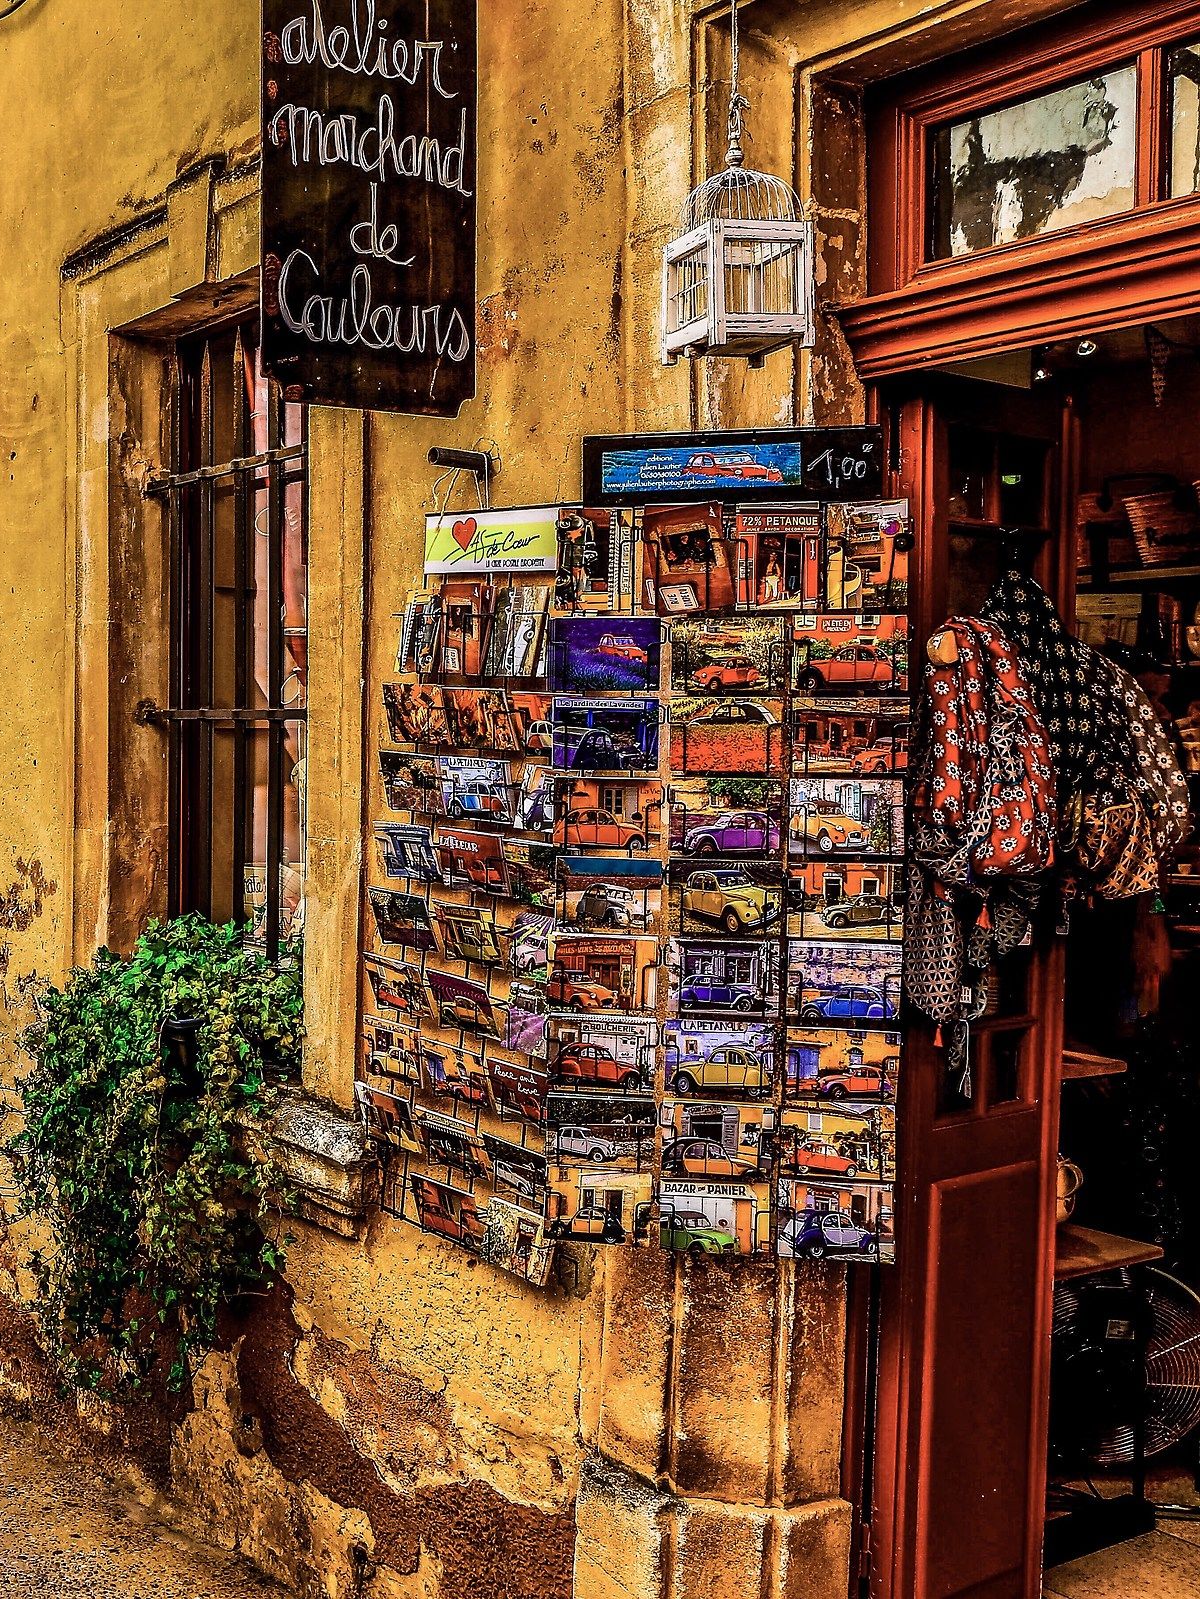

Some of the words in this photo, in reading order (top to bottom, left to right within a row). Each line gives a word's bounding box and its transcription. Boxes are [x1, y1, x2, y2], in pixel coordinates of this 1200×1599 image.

[282, 0, 458, 98] atelier
[272, 94, 472, 197] marchand
[350, 182, 415, 266] de
[278, 249, 470, 361] Couleurs
[742, 516, 762, 526] 72%
[766, 516, 818, 526] PETANQUE
[591, 1023, 637, 1033] BOUCHERIE
[683, 1020, 697, 1030] LA
[664, 1183, 697, 1194] BAZAR
[707, 1184, 747, 1197] PANIER
